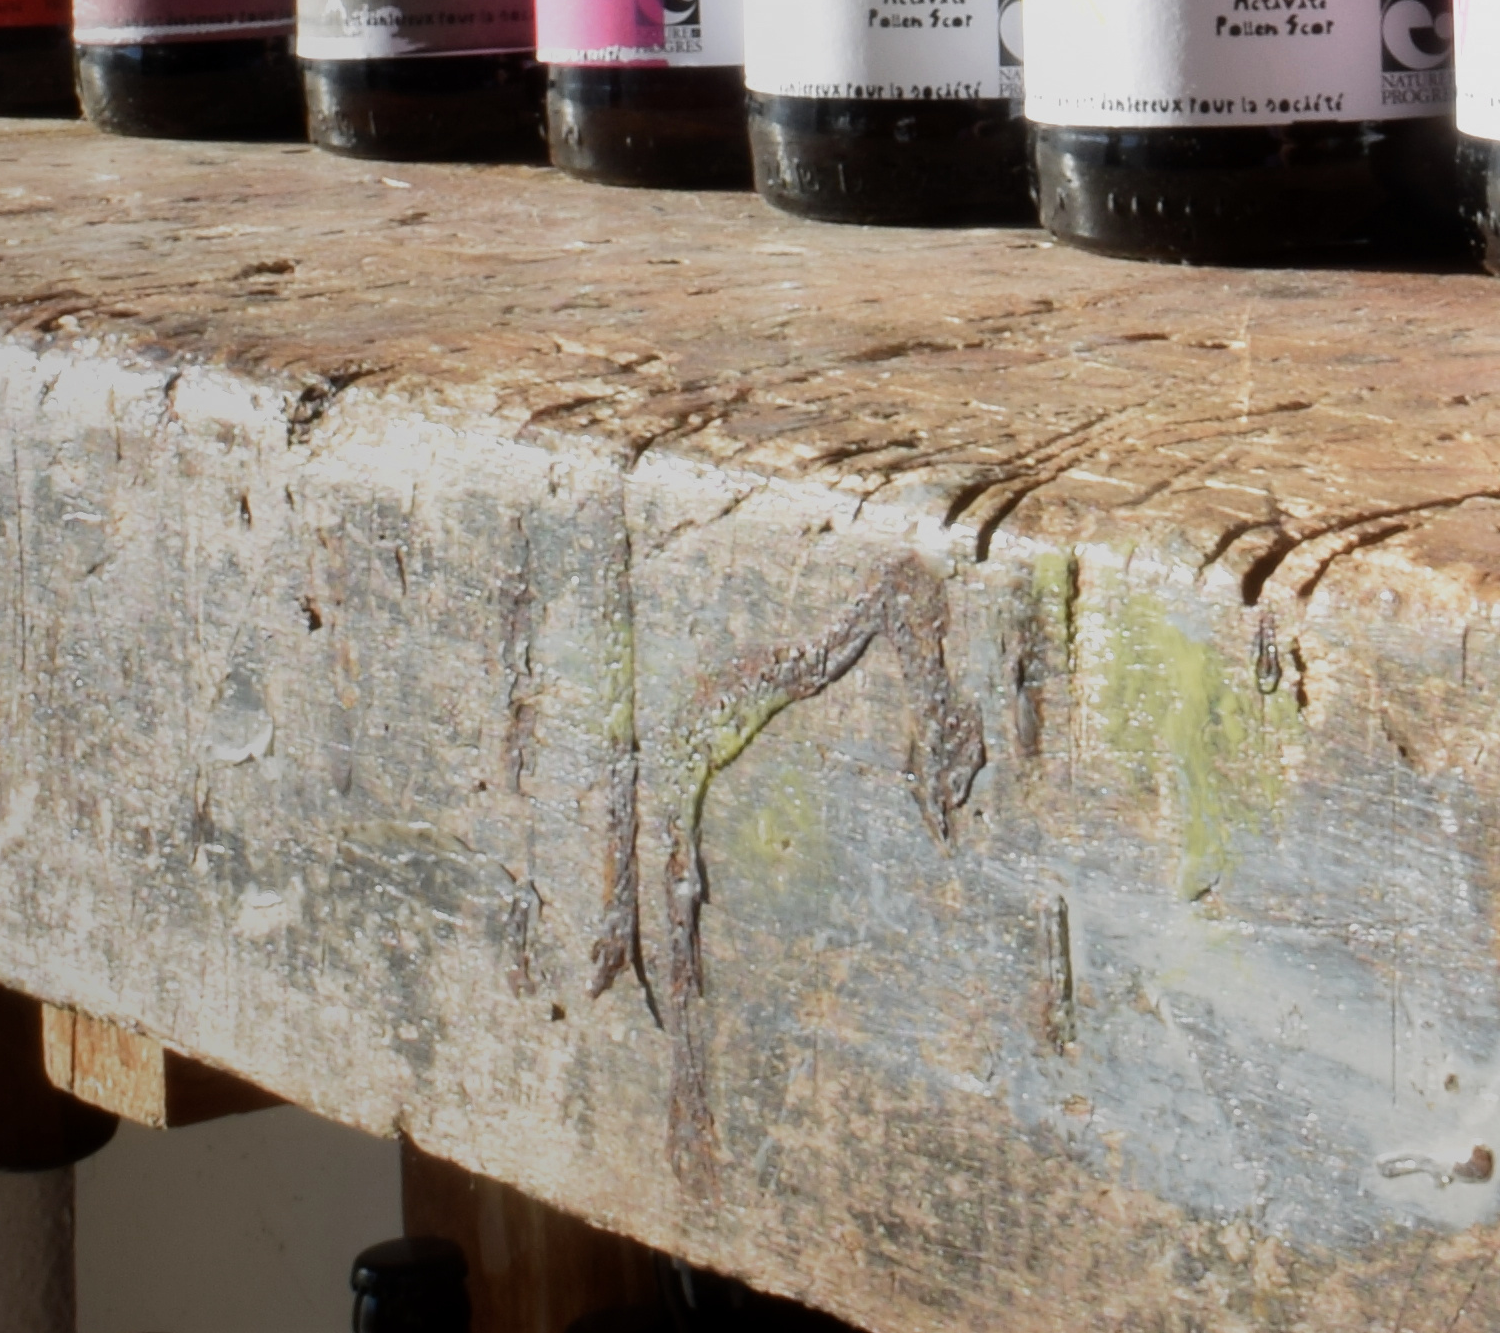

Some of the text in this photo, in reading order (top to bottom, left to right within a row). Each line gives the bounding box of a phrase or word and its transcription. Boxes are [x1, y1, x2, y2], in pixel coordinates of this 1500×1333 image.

[1215, 15, 1334, 37] Pollen Scop
[1189, 93, 1344, 115] pour la société
